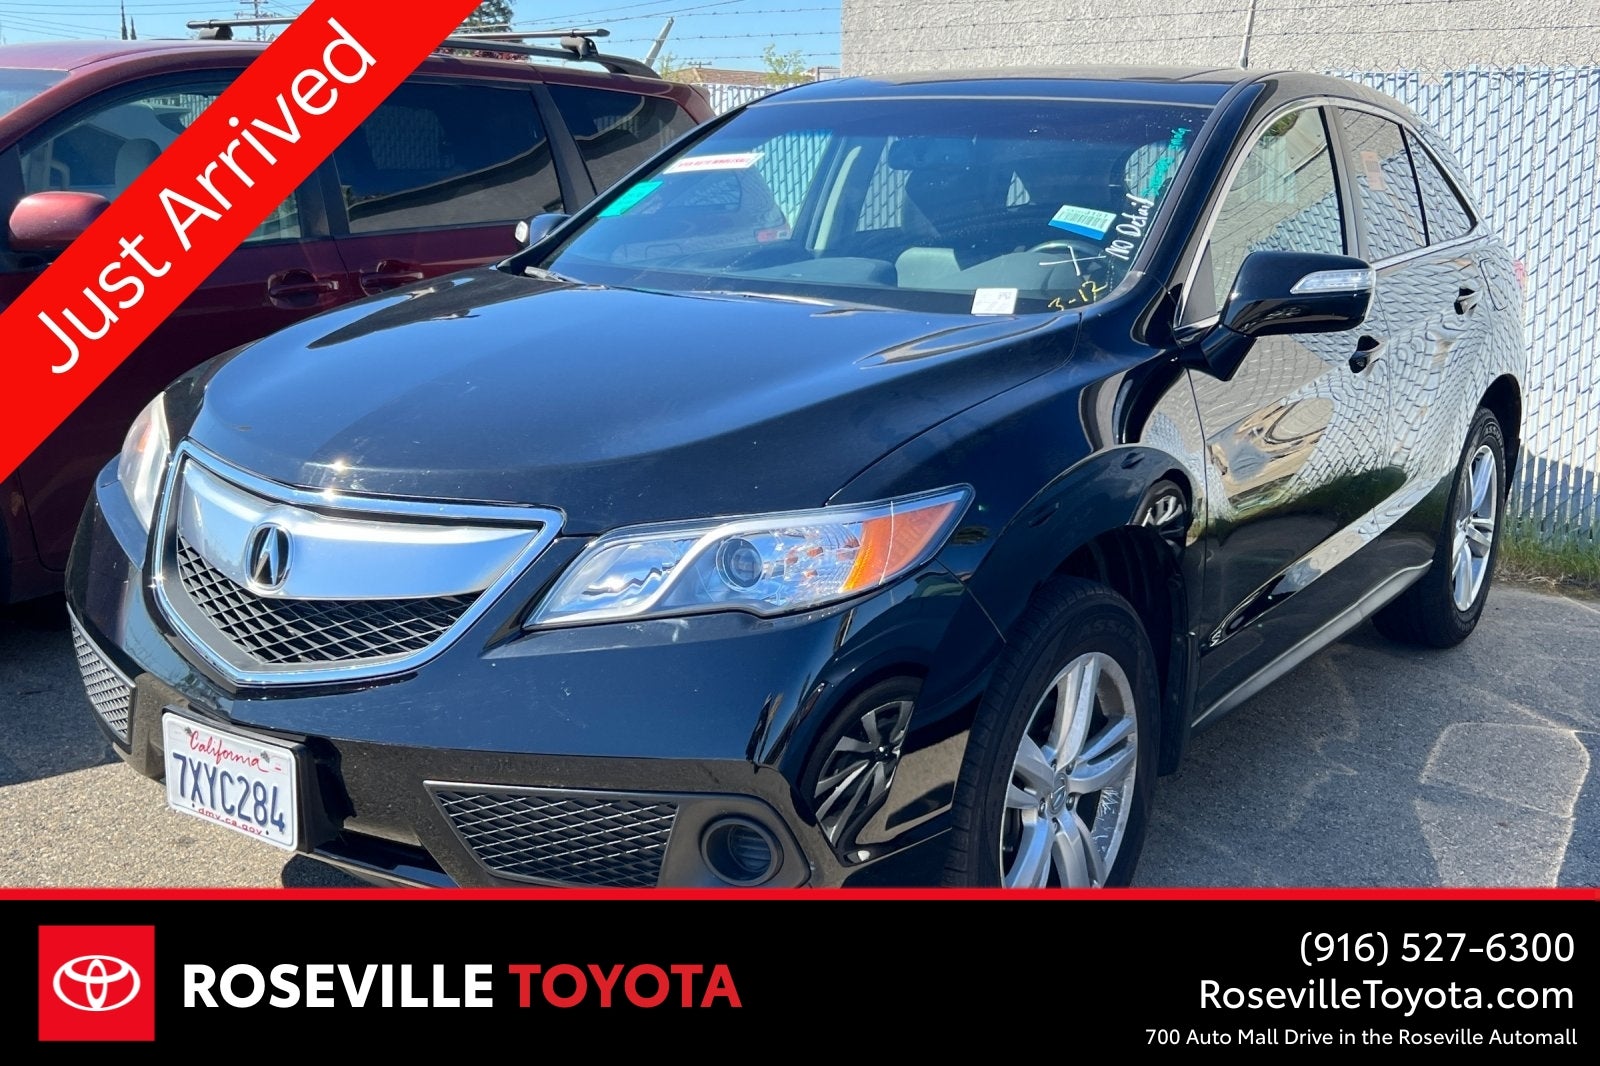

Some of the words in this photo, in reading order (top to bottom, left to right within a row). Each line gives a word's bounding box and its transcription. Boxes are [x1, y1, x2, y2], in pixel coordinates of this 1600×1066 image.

[189, 730, 269, 773] California
[172, 751, 286, 833] 7XYC284
[197, 807, 263, 836] dmv.ca.gov
